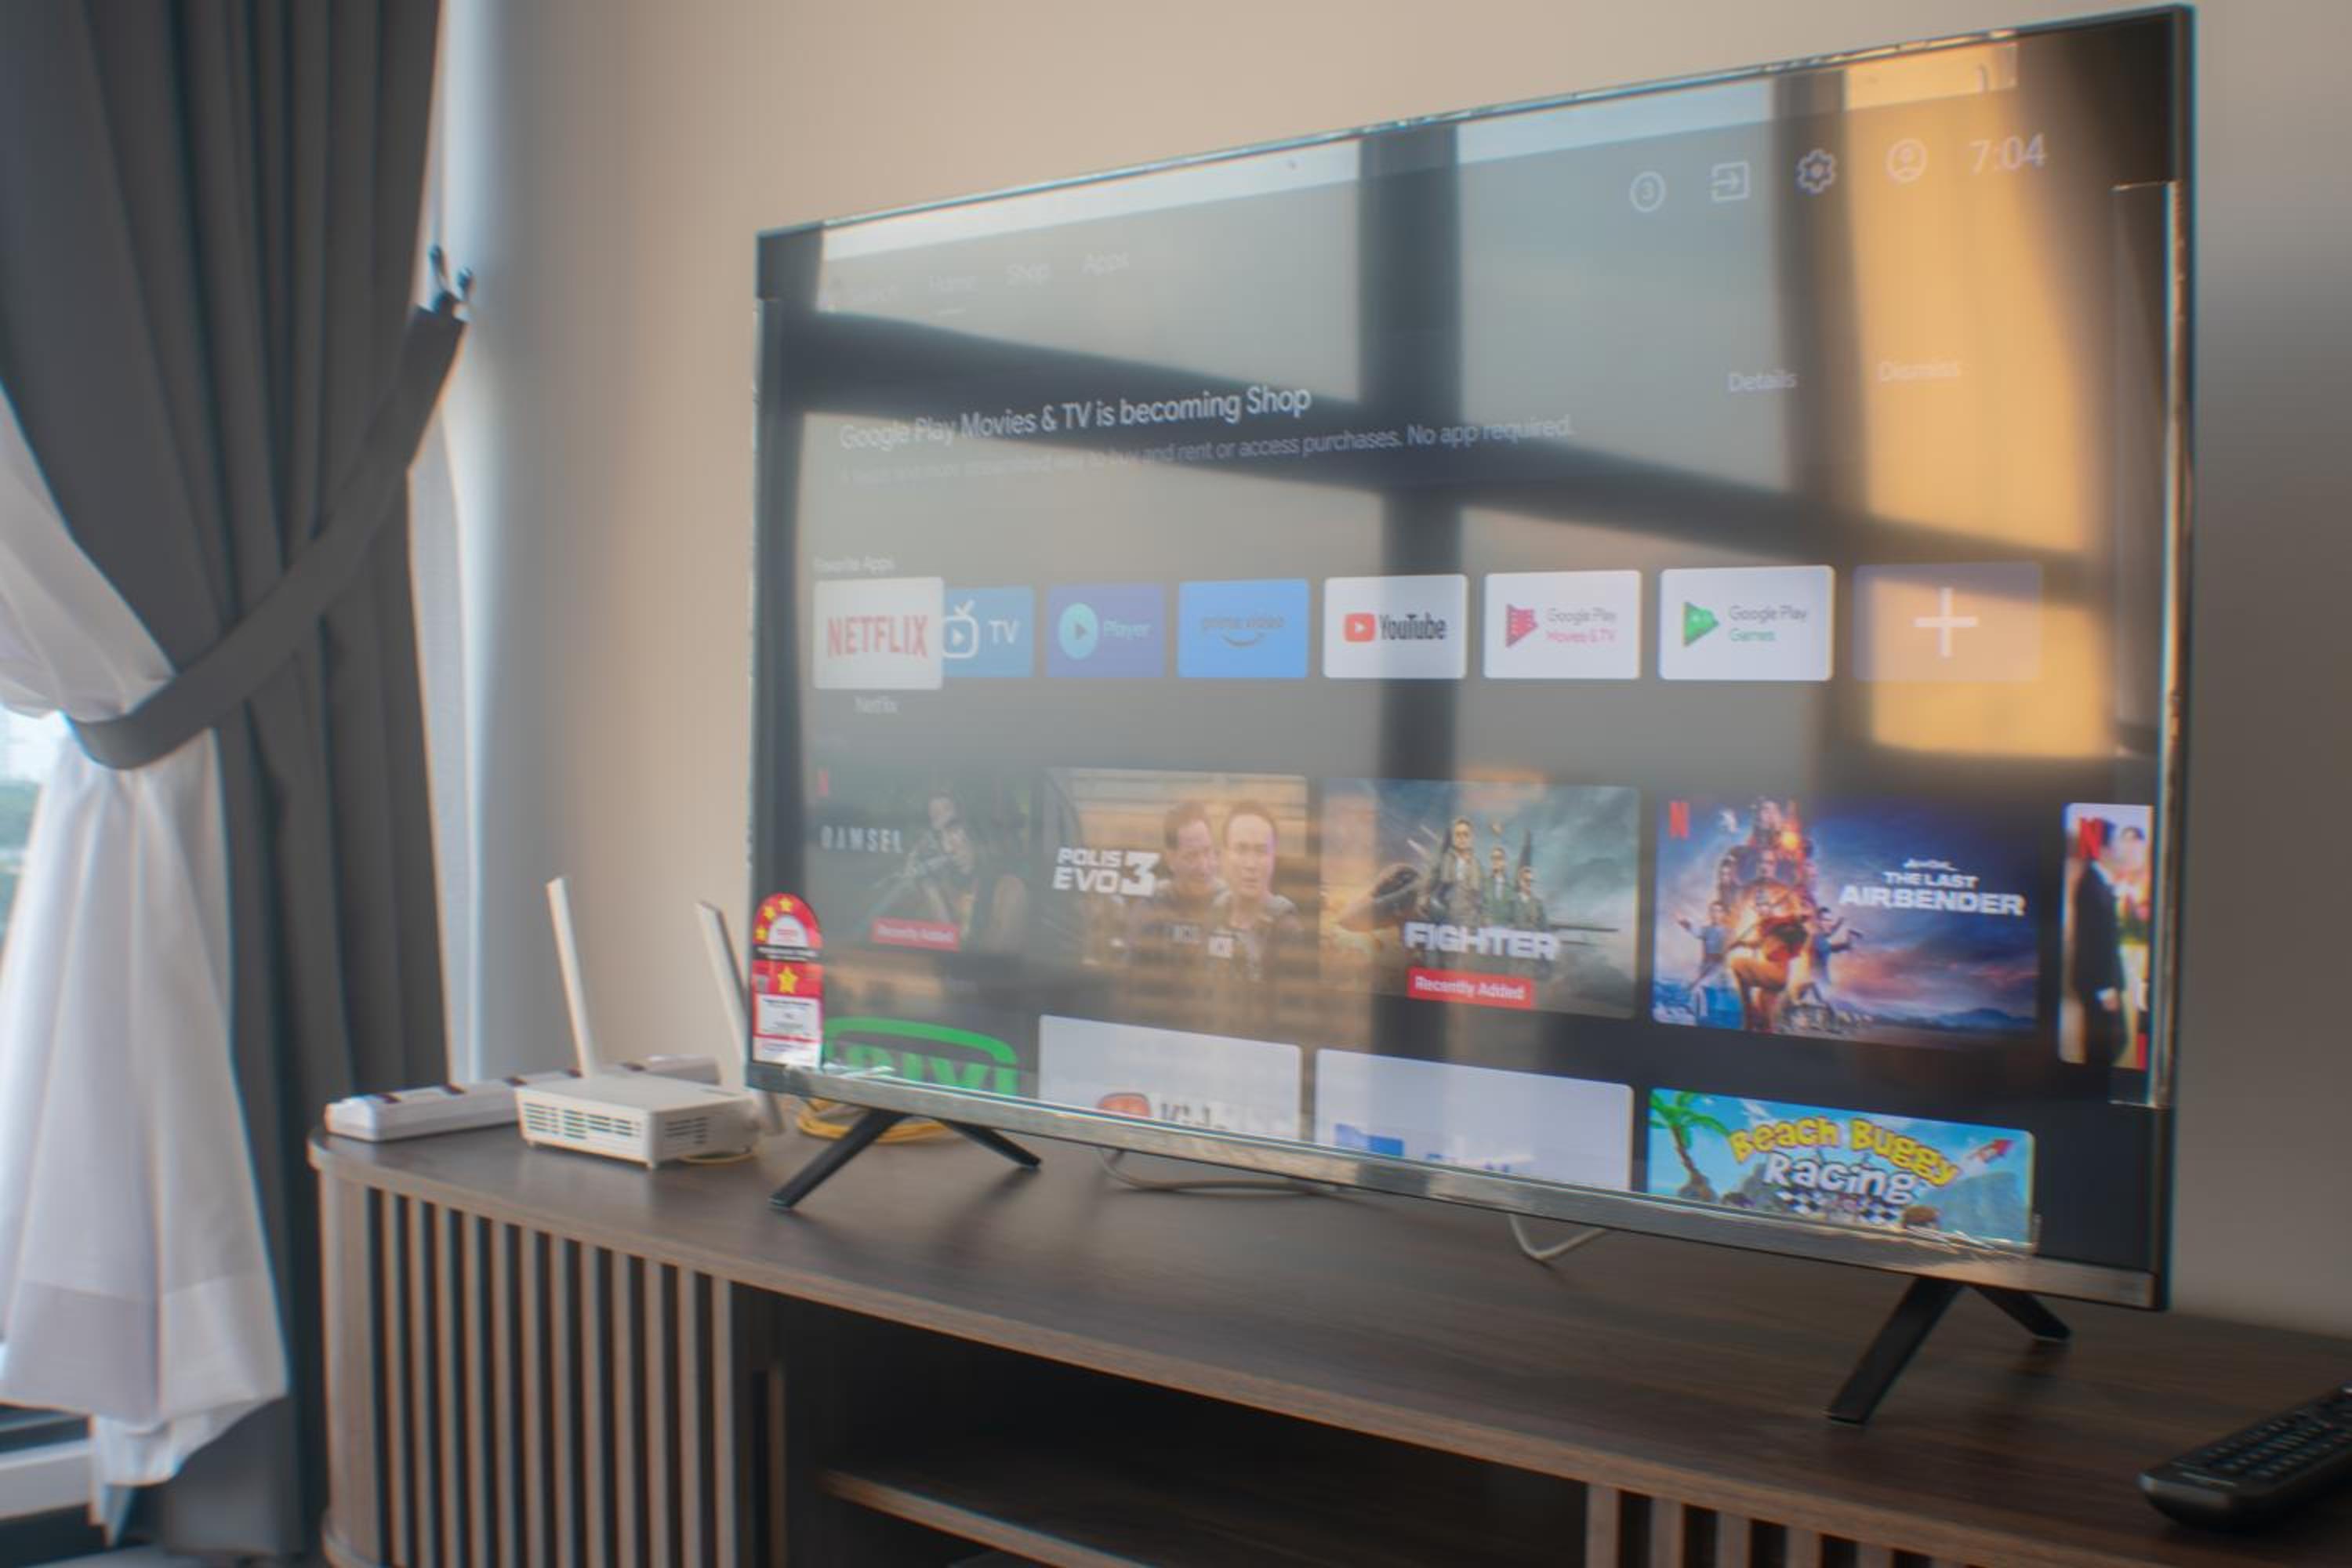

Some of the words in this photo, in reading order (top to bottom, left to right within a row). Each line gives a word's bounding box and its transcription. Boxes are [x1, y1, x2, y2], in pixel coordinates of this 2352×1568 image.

[1969, 133, 2047, 175] 7:04
[1727, 368, 1798, 393] Details
[839, 423, 909, 452] Google
[914, 416, 955, 447] Play
[960, 408, 1036, 439] Movies
[1040, 403, 1058, 432] &
[1062, 401, 1091, 430] TV
[1096, 399, 1115, 426] is
[1119, 390, 1242, 426] becoming
[1246, 385, 1312, 418] Shop
[1177, 440, 1213, 461] rent
[1216, 441, 1236, 459] or
[1238, 435, 1299, 459] access
[1301, 426, 1403, 458] purchases.
[1406, 424, 1436, 446] No
[1441, 426, 1479, 450] app
[1479, 414, 1572, 444] required.
[1380, 611, 1448, 641] YouTube
[1545, 606, 1589, 627] Google
[1592, 605, 1618, 625] Play
[1728, 604, 1777, 625] Google
[1779, 603, 1808, 623] Play
[827, 614, 928, 659] NETFLIX
[988, 619, 1021, 644] TV
[1102, 619, 1152, 641] Player
[1728, 627, 1777, 643] Games
[820, 823, 904, 855] DAMSEL
[1058, 847, 1123, 868] POLIS
[1053, 866, 1119, 894] EVO
[1882, 870, 1921, 886] THE
[1923, 873, 1980, 890] LAST
[1838, 884, 2027, 917] AIRBENDER
[1403, 920, 1560, 961] FIGHTER
[1414, 975, 1475, 998] Recently
[1477, 982, 1526, 1000] Added
[1728, 1116, 1842, 1165] Beach
[1848, 1116, 1961, 1189] Buggy
[1762, 1149, 1920, 1207] Racing
